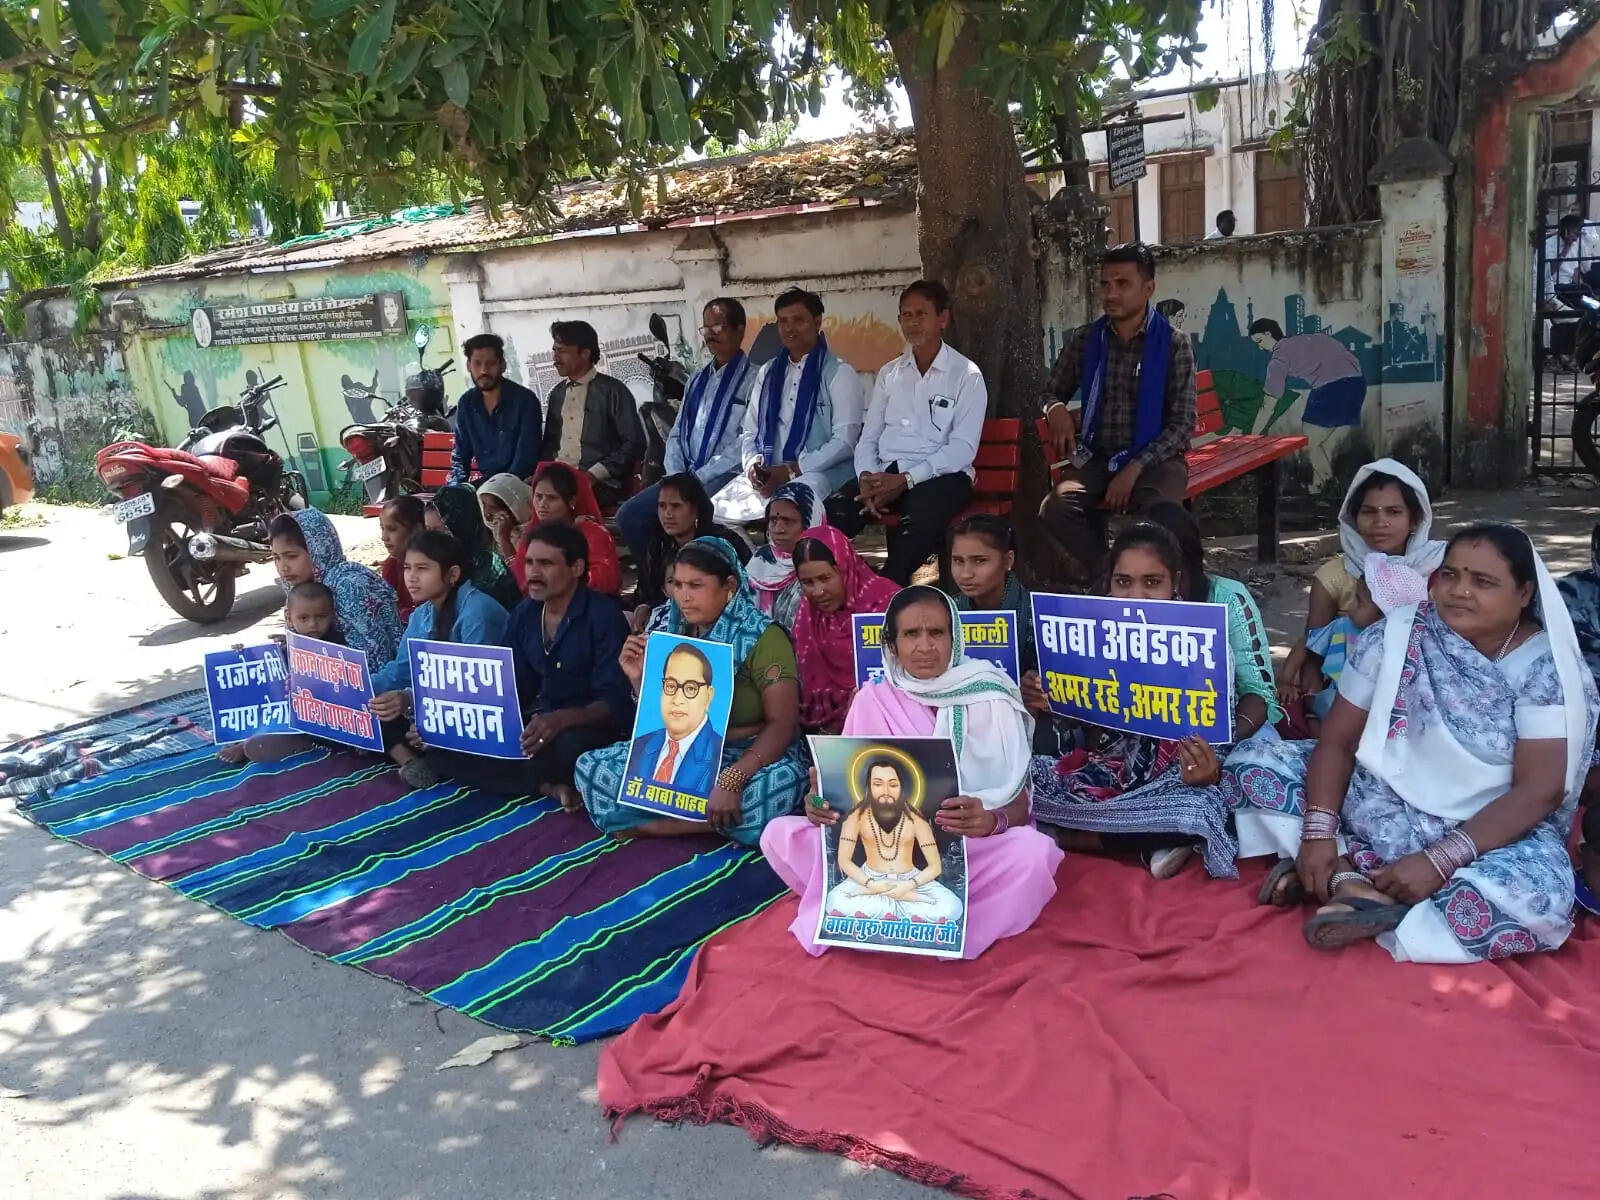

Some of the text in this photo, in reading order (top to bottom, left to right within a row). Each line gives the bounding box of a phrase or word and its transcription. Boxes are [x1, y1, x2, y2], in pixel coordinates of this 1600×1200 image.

[1039, 607, 1217, 670] बाबा अंबेडकर
[214, 654, 266, 690] राजेन्द्र
[416, 651, 504, 697] आमरण
[218, 695, 290, 732] न्याय देना
[1046, 670, 1093, 710] अमर
[1094, 668, 1120, 715] रहे
[1185, 679, 1218, 727] रहे
[324, 702, 356, 736] वापस
[353, 704, 375, 740] लो
[422, 696, 505, 743] अनशन
[626, 776, 708, 816] डॉ. बाबा साहब
[826, 916, 855, 935] बाबा
[853, 916, 880, 942] गुरु
[936, 920, 958, 945] जी
